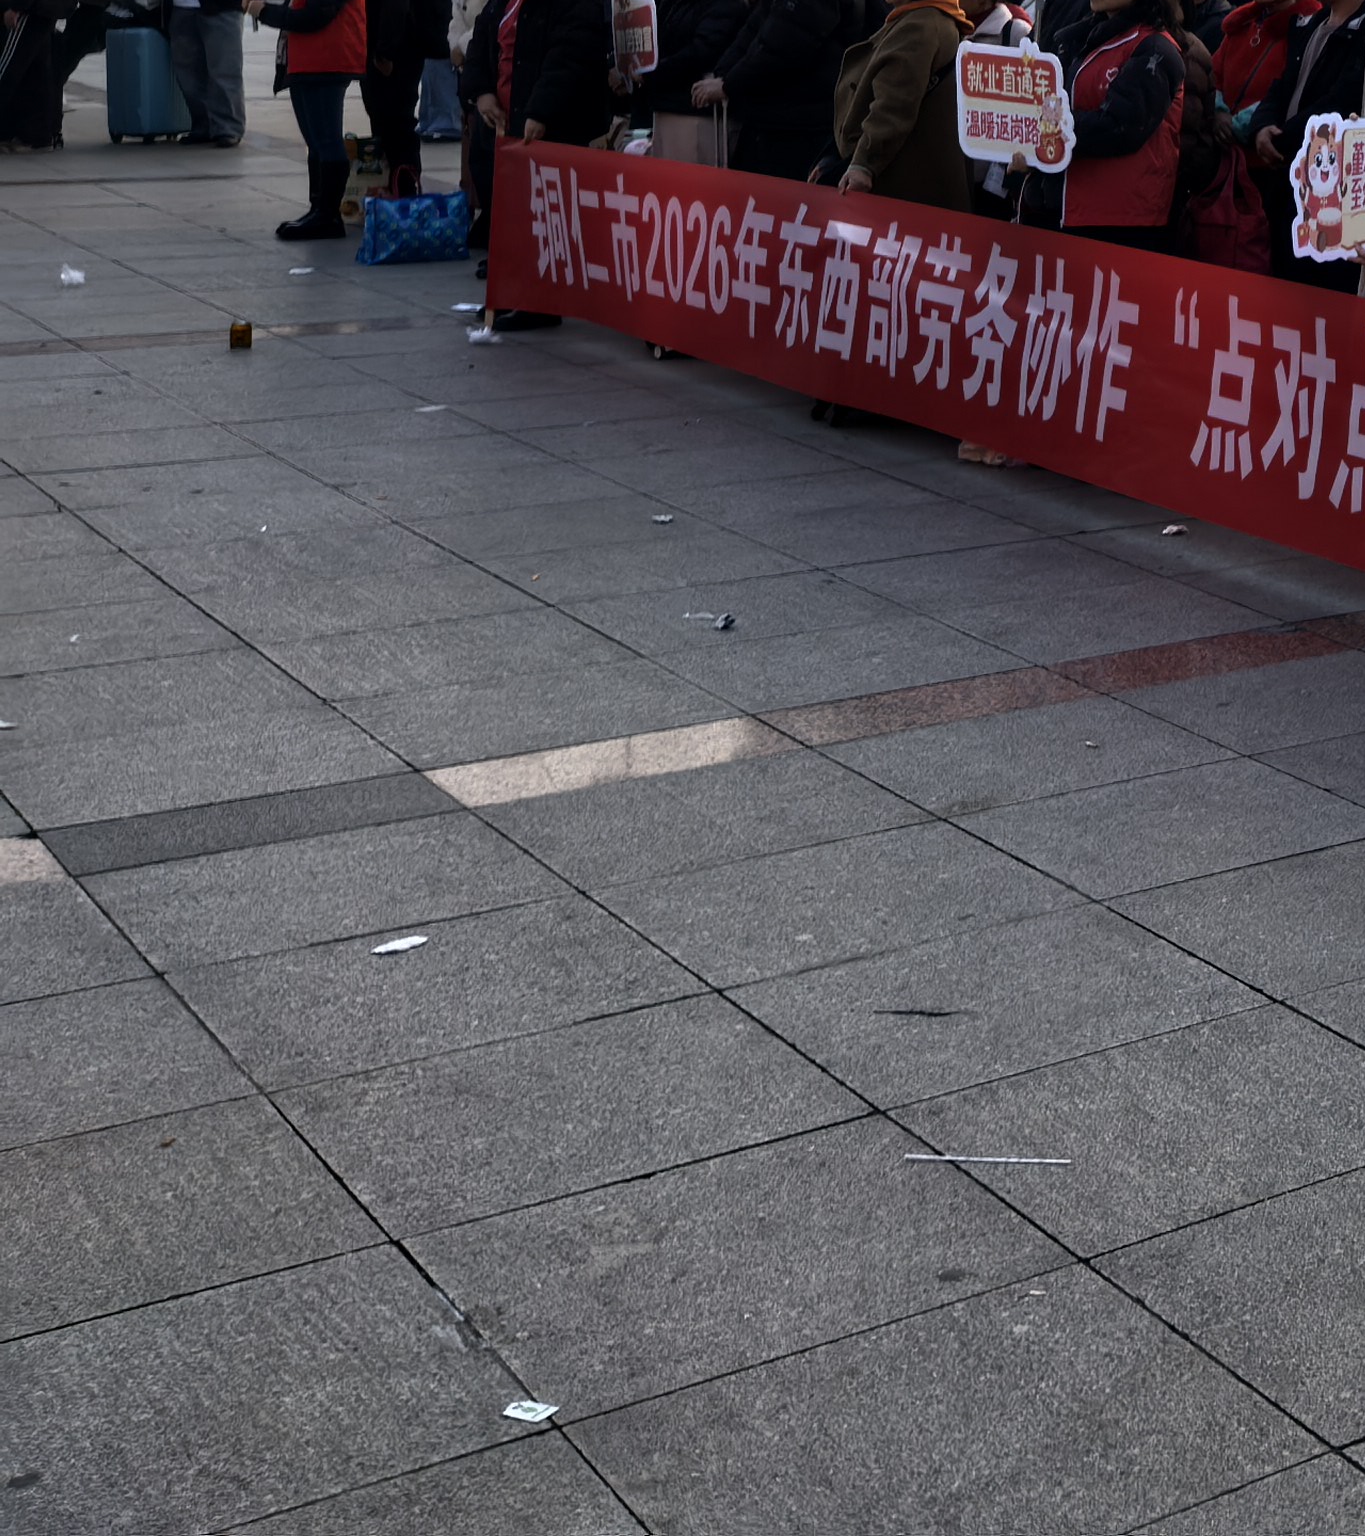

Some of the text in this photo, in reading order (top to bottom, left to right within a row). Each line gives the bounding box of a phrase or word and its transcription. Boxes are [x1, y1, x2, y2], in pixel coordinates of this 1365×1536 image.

[967, 60, 1051, 100] 就业直通车
[966, 109, 1041, 147] 温暖返岗路
[529, 159, 1140, 441] 铜仁市2026年东西部劳务协作
